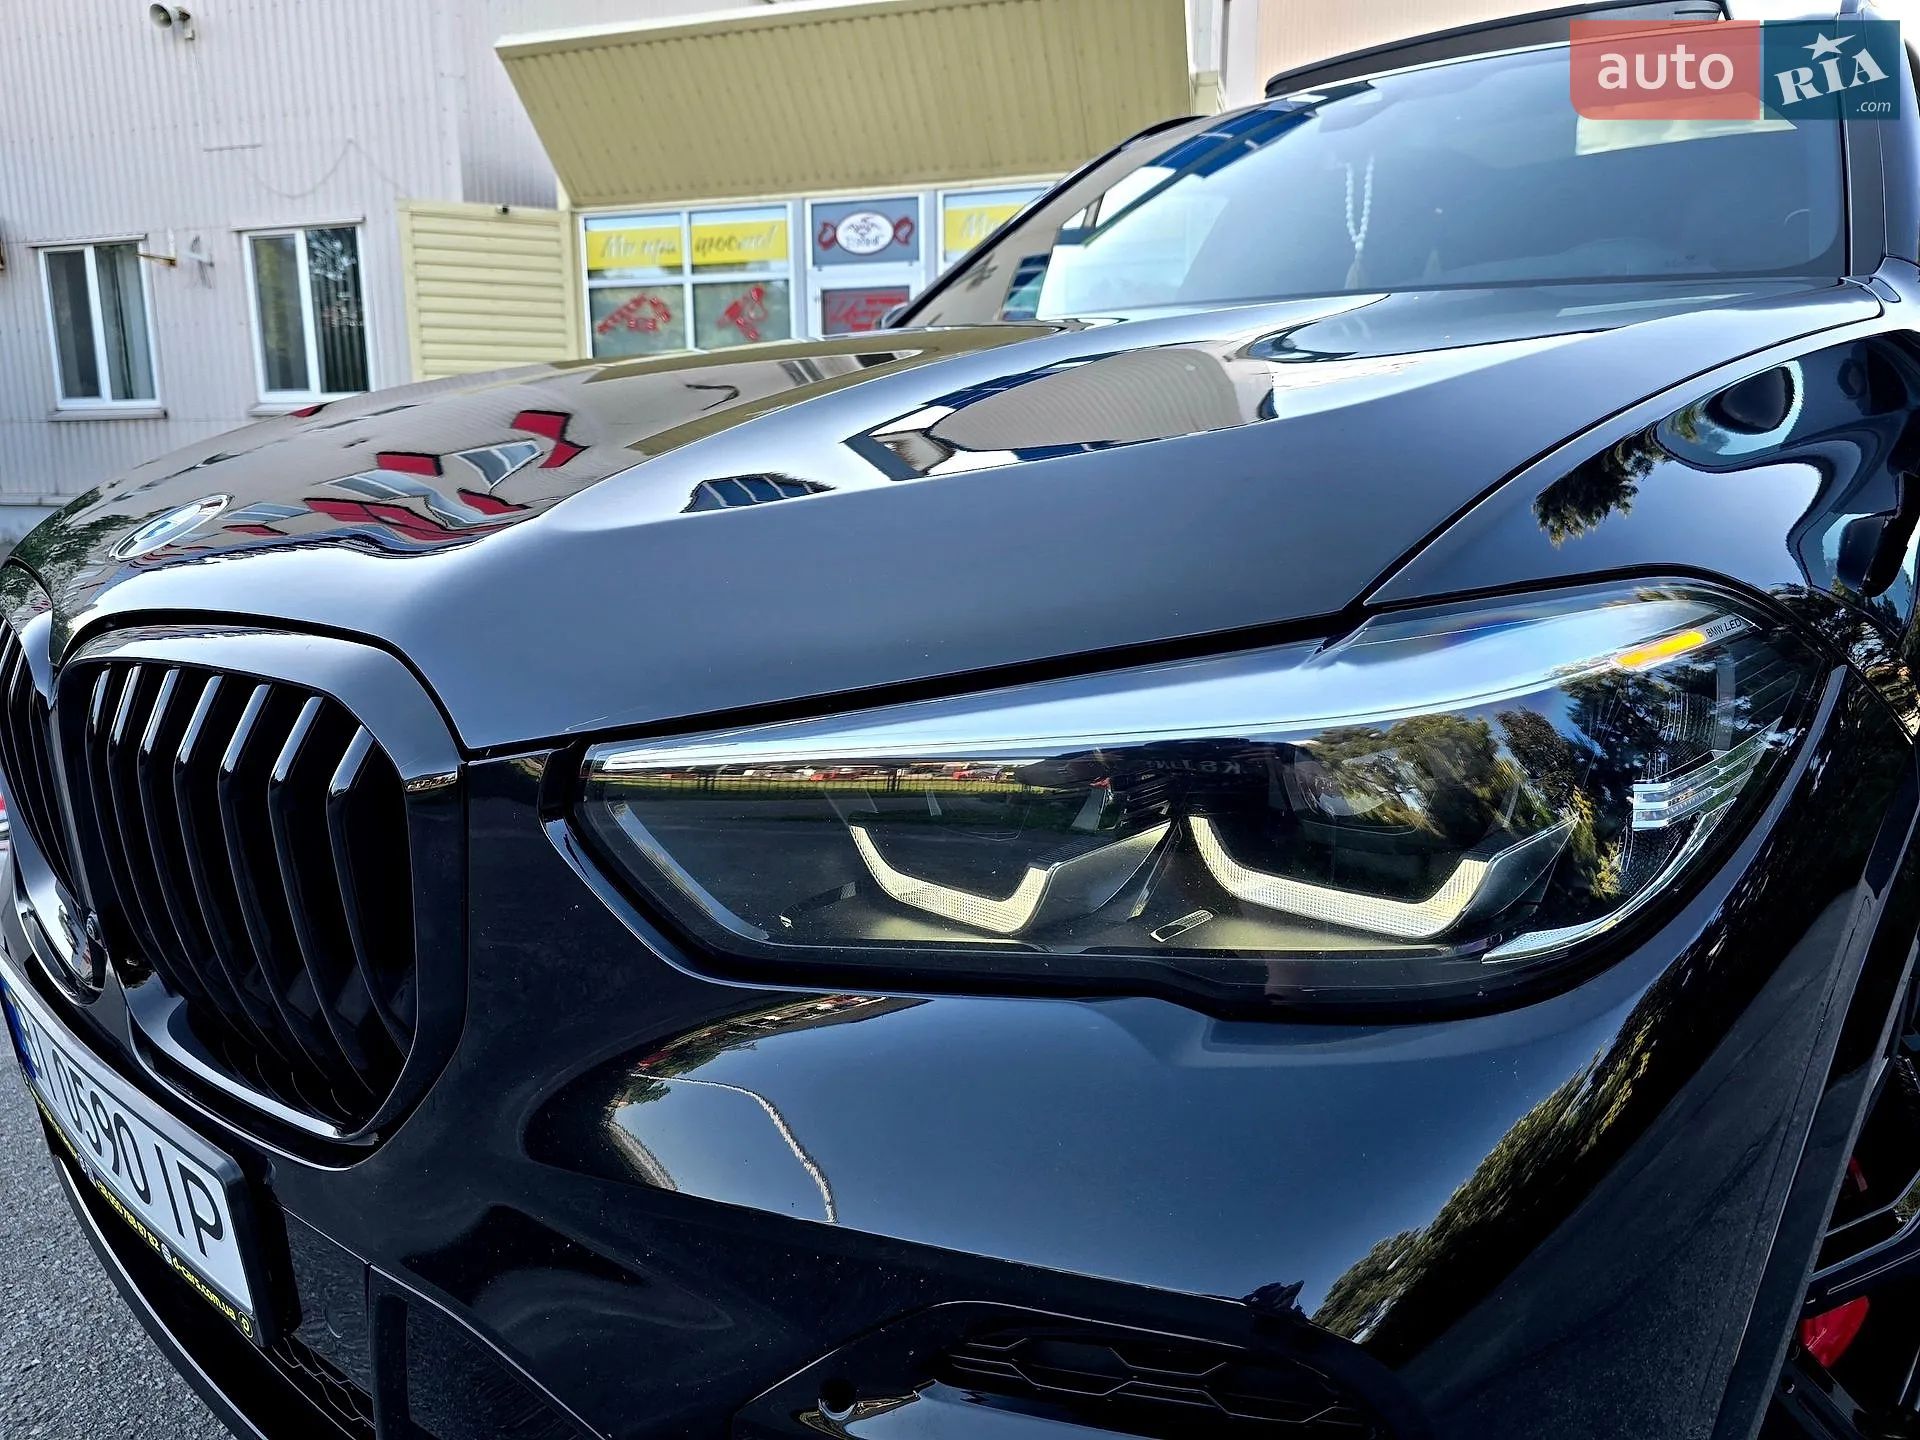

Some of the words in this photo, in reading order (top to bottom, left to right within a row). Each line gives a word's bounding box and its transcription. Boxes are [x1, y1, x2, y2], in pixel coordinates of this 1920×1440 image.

[1706, 624, 1724, 638] BMW
[1724, 618, 1742, 631] LED
[52, 1048, 153, 1205] 0590
[153, 1142, 225, 1258] IP
